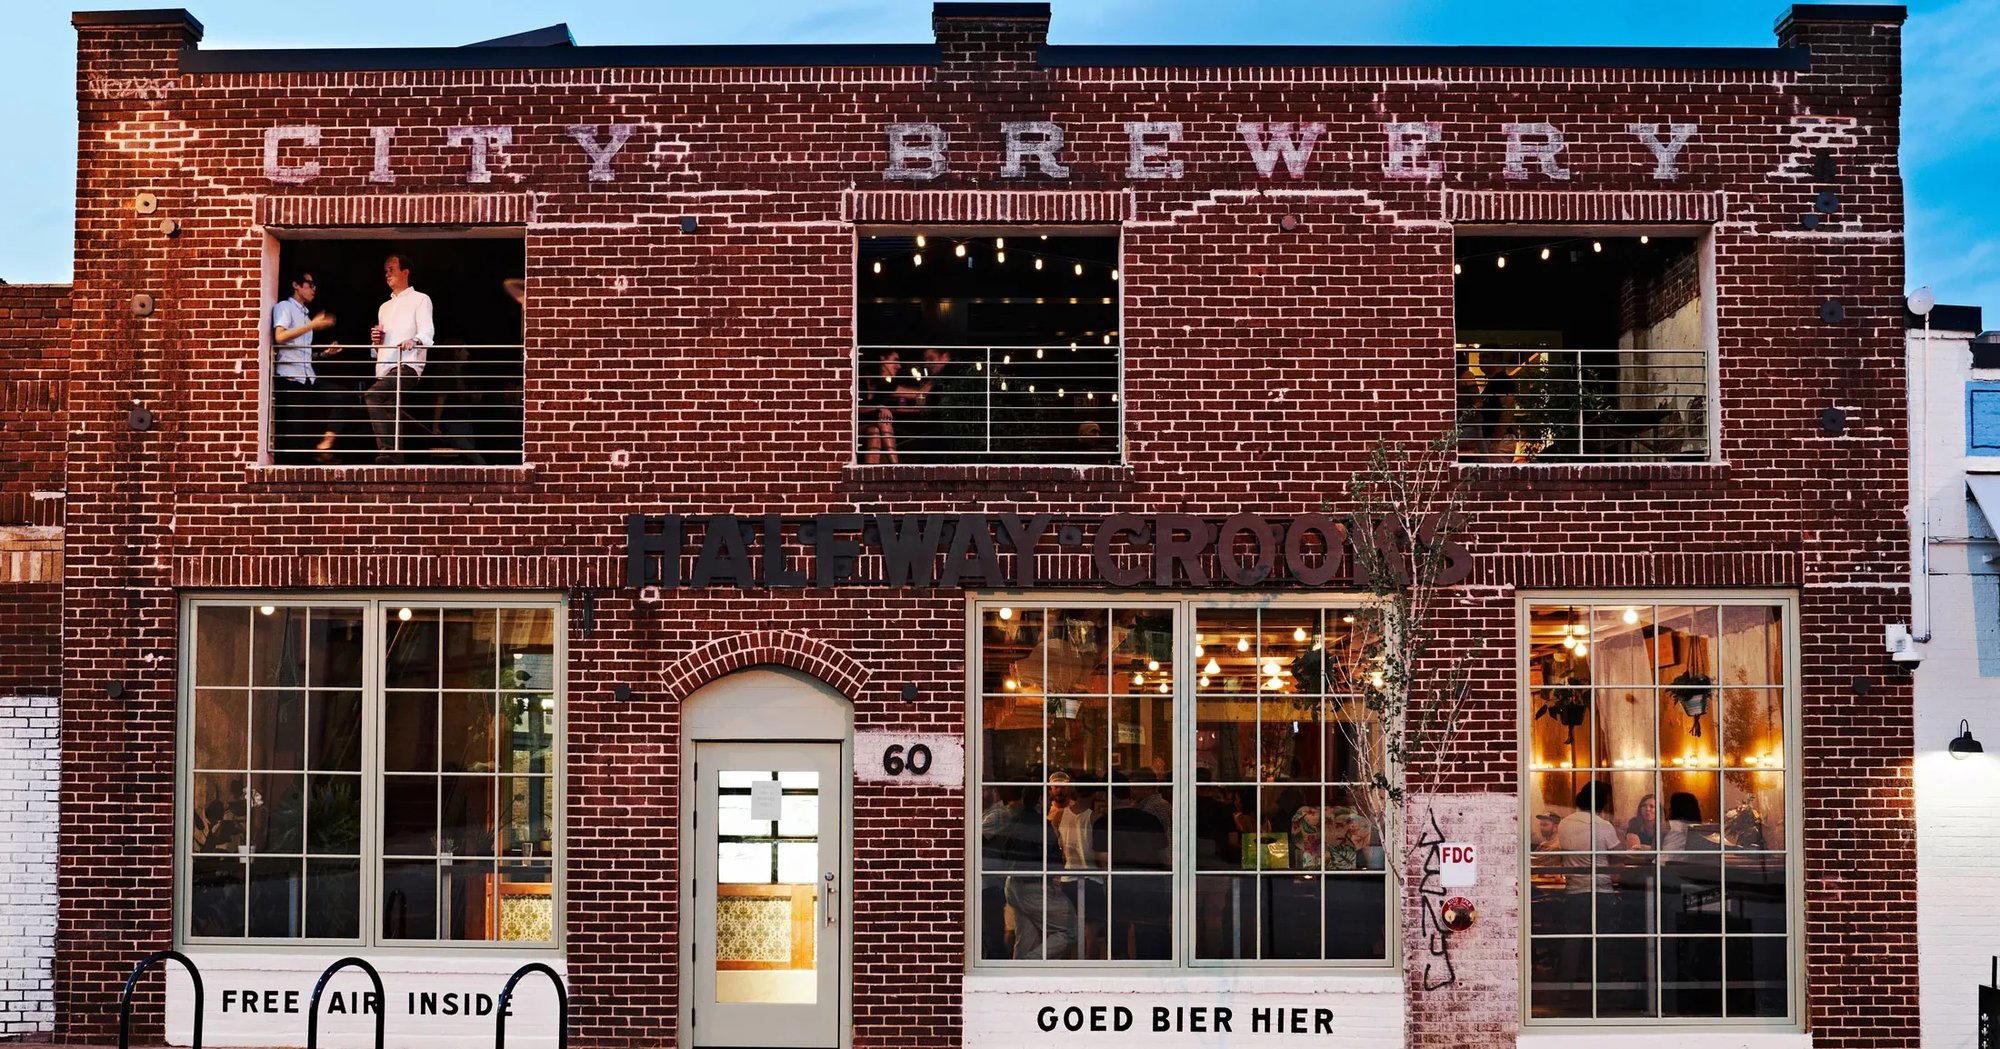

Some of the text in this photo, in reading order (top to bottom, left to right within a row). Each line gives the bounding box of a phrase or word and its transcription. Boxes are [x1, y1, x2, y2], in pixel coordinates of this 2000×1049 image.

[264, 121, 1698, 184] CITY BREWERY
[627, 512, 1472, 588] HALFWAY CROOKS
[883, 743, 932, 776] 60
[1442, 847, 1474, 864] FDC
[222, 990, 300, 1013] FREE
[327, 991, 383, 1015] AIR
[1037, 1006, 1334, 1034] GOED BIER HIER
